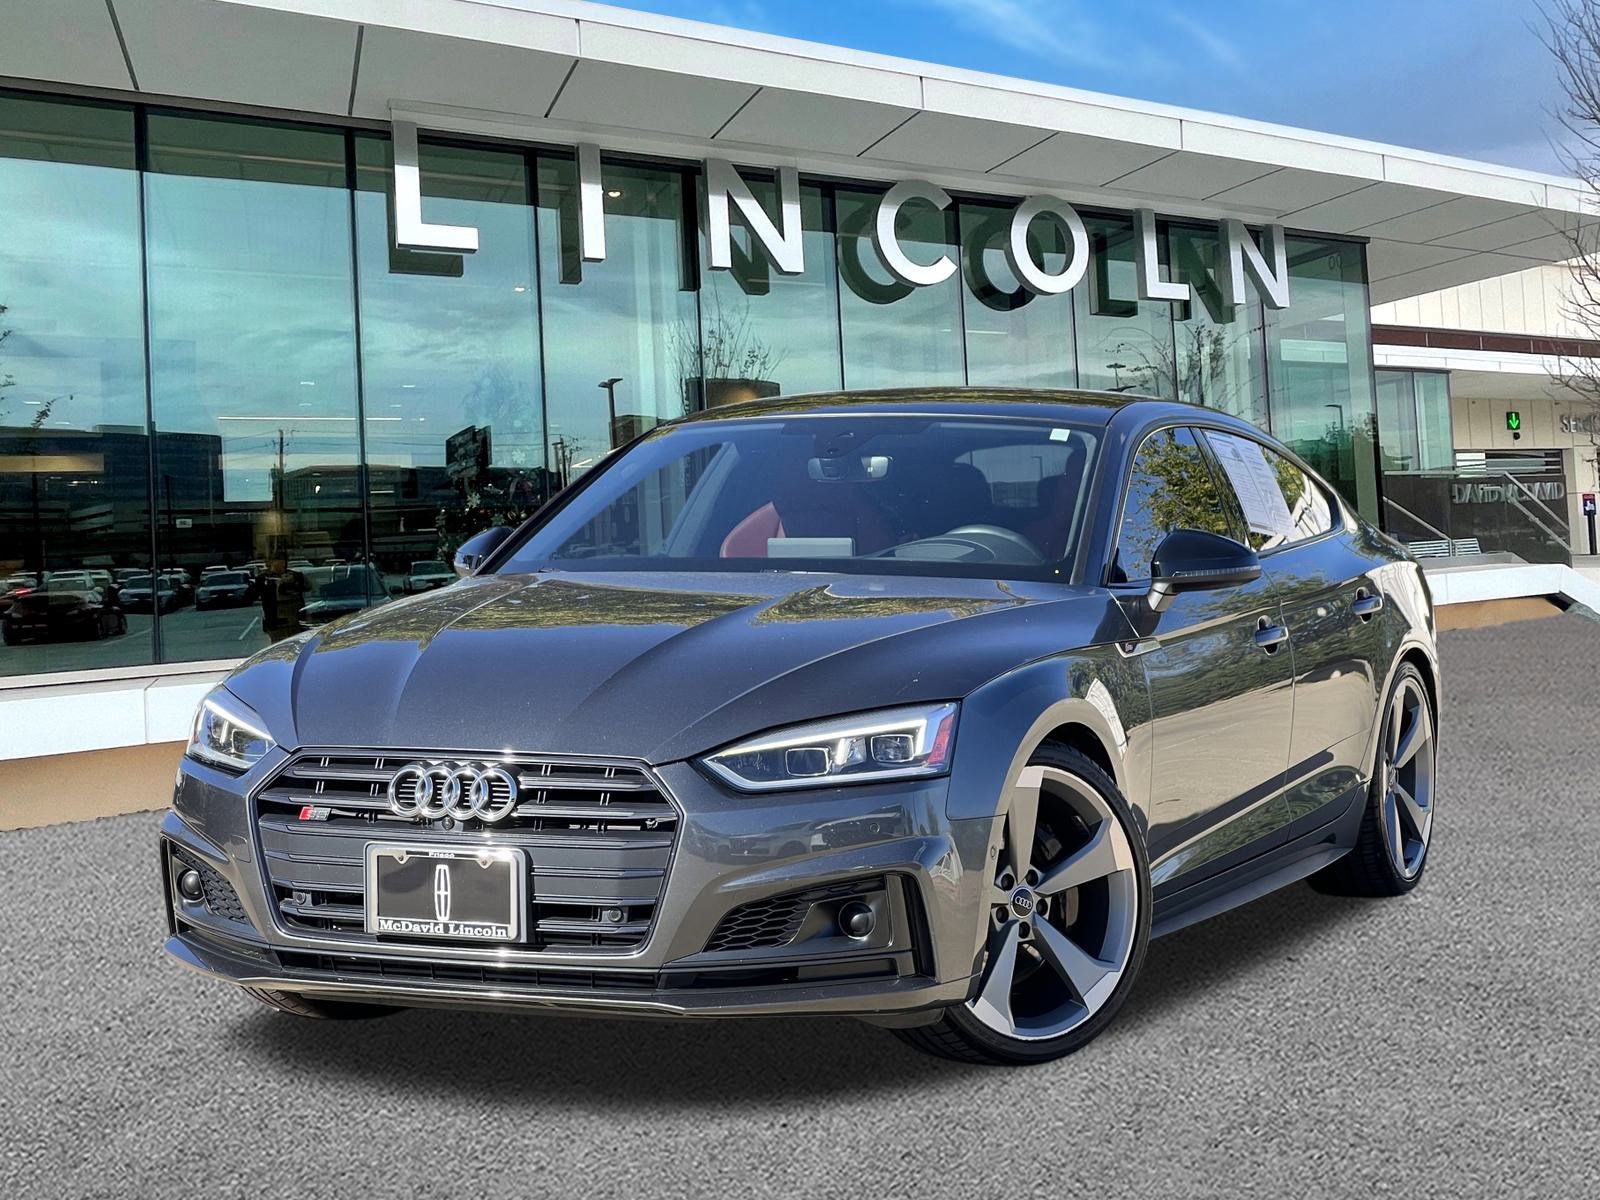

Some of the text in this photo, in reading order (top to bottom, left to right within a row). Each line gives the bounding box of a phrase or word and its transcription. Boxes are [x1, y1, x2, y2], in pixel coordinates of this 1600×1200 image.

[392, 120, 1290, 309] LINCOLN
[379, 919, 507, 937] McDavid Lincoln
